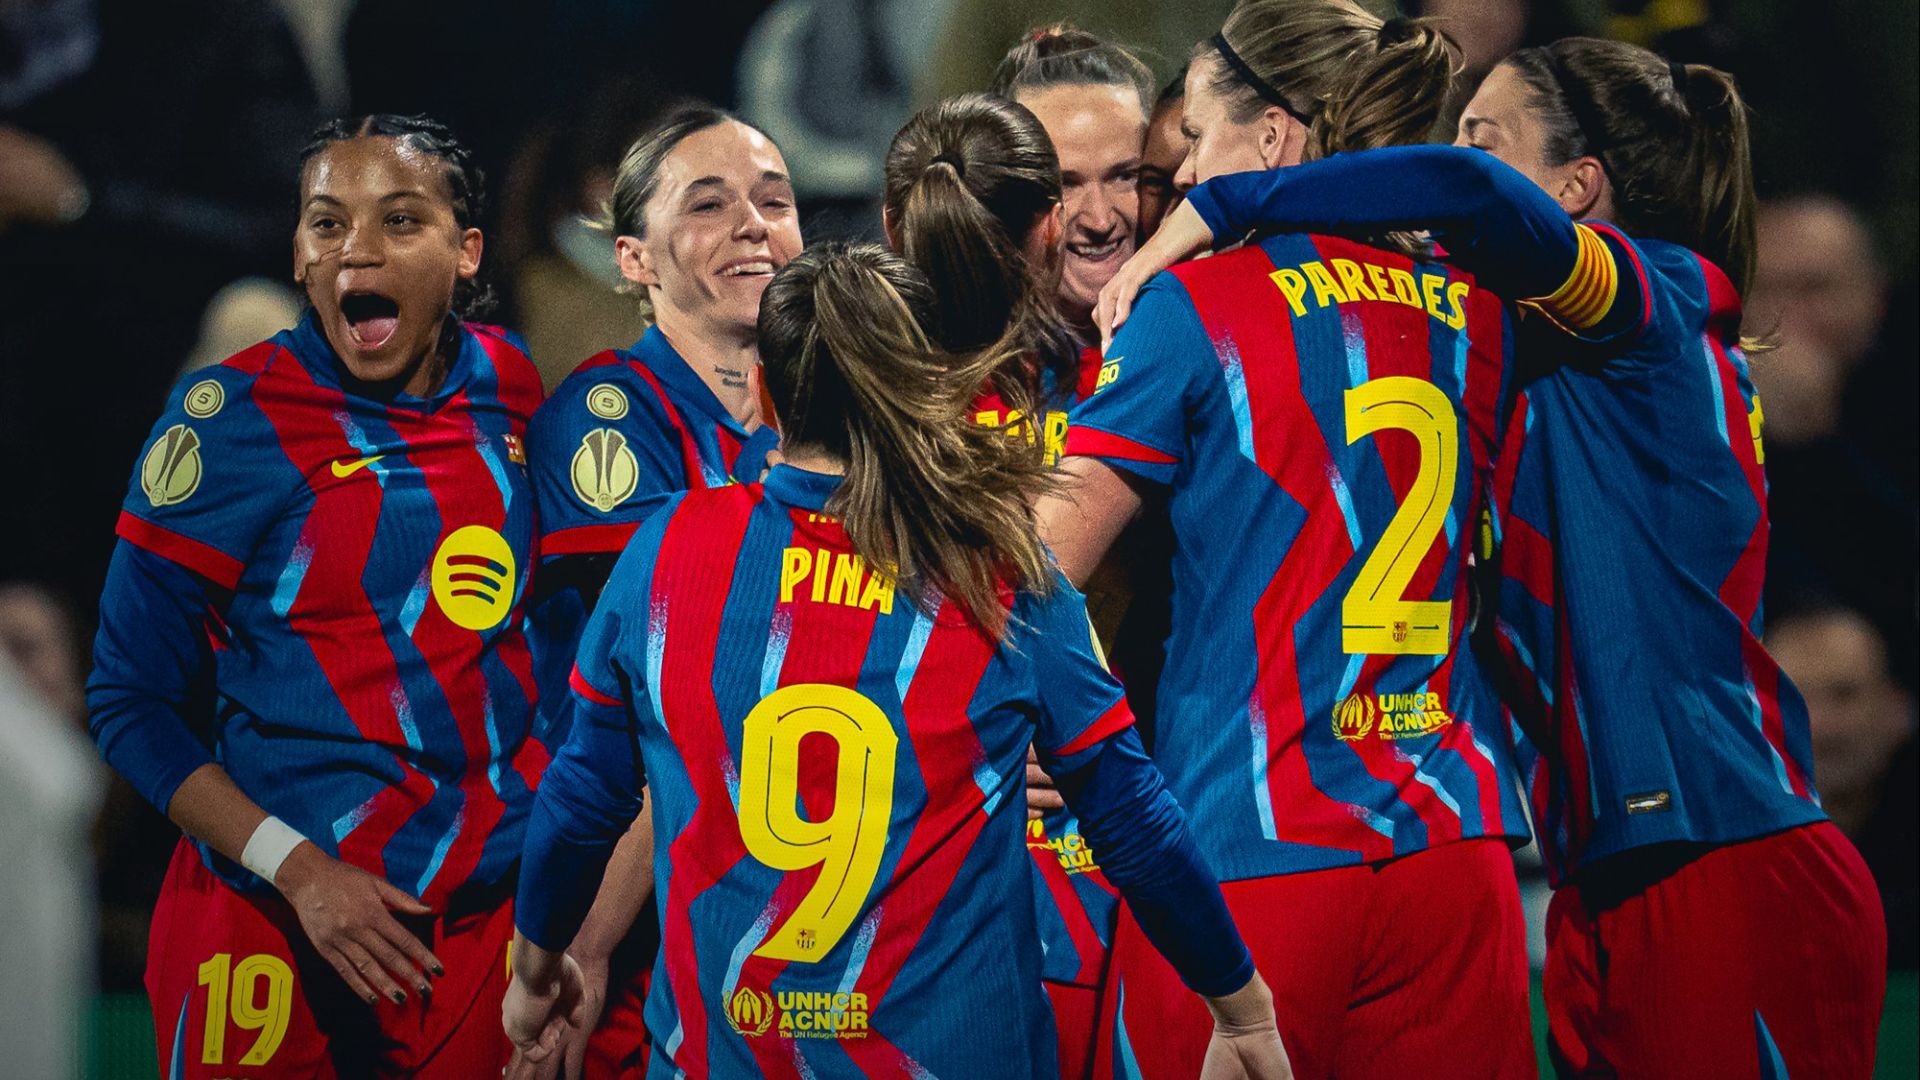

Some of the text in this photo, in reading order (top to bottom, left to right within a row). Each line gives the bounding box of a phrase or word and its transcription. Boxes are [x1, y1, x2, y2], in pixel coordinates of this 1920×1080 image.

[1268, 258, 1470, 331] PAREDES
[1342, 375, 1459, 656] 2
[780, 547, 898, 615] PINA
[1378, 692, 1442, 712] UNHCR
[738, 683, 899, 964] 9
[198, 953, 295, 1066] 19
[778, 991, 868, 1010] UNHCR
[778, 1011, 868, 1031] ACNUR
